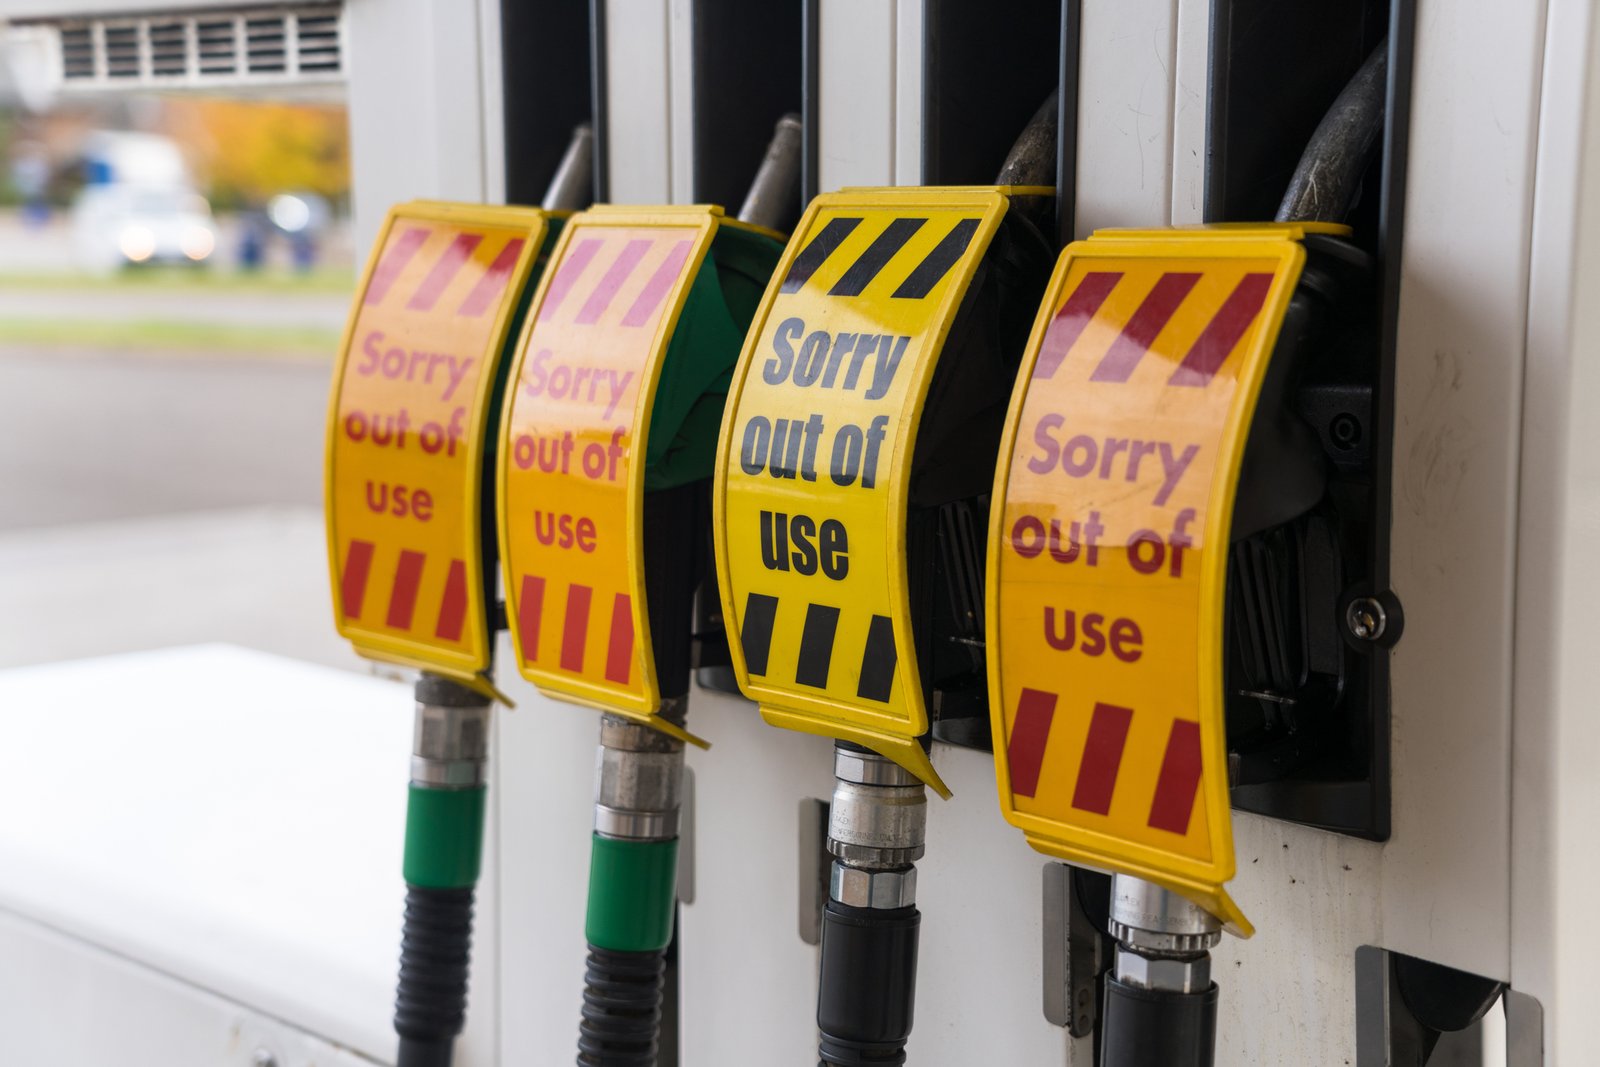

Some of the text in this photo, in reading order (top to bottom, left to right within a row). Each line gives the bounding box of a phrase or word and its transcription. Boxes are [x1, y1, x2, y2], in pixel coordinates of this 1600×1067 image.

[357, 332, 474, 402] Sorry
[525, 349, 635, 421] Sorry
[762, 317, 910, 400] Sorry
[345, 408, 465, 457] out of
[513, 427, 625, 481] out of
[740, 414, 889, 489] out of
[1027, 413, 1201, 506] Sorry
[366, 481, 434, 522] use
[534, 511, 598, 554] use
[760, 511, 849, 581] use
[1011, 508, 1196, 578] out of
[1043, 606, 1144, 663] use
